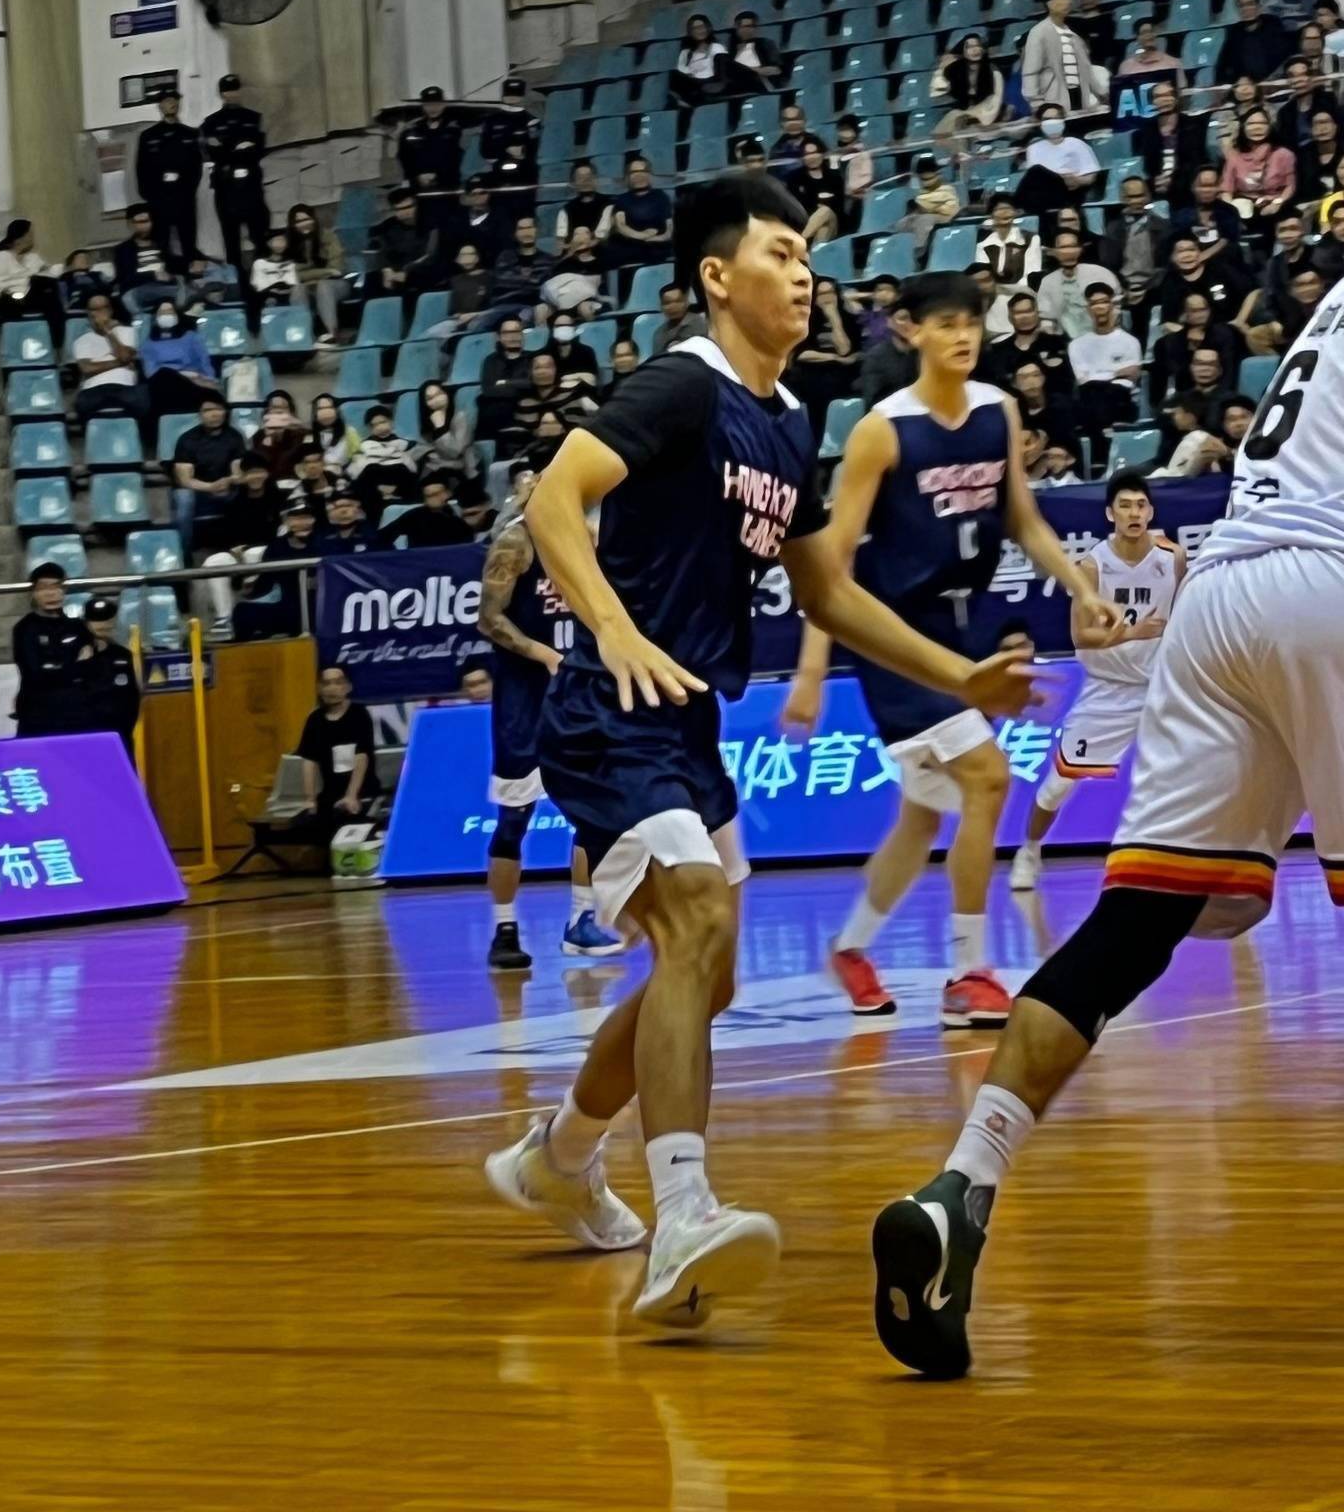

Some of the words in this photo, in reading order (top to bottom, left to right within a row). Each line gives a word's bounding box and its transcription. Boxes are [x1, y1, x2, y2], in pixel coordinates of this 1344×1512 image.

[1244, 349, 1319, 461] 6
[341, 575, 484, 635] molte
[1074, 738, 1088, 758] 3
